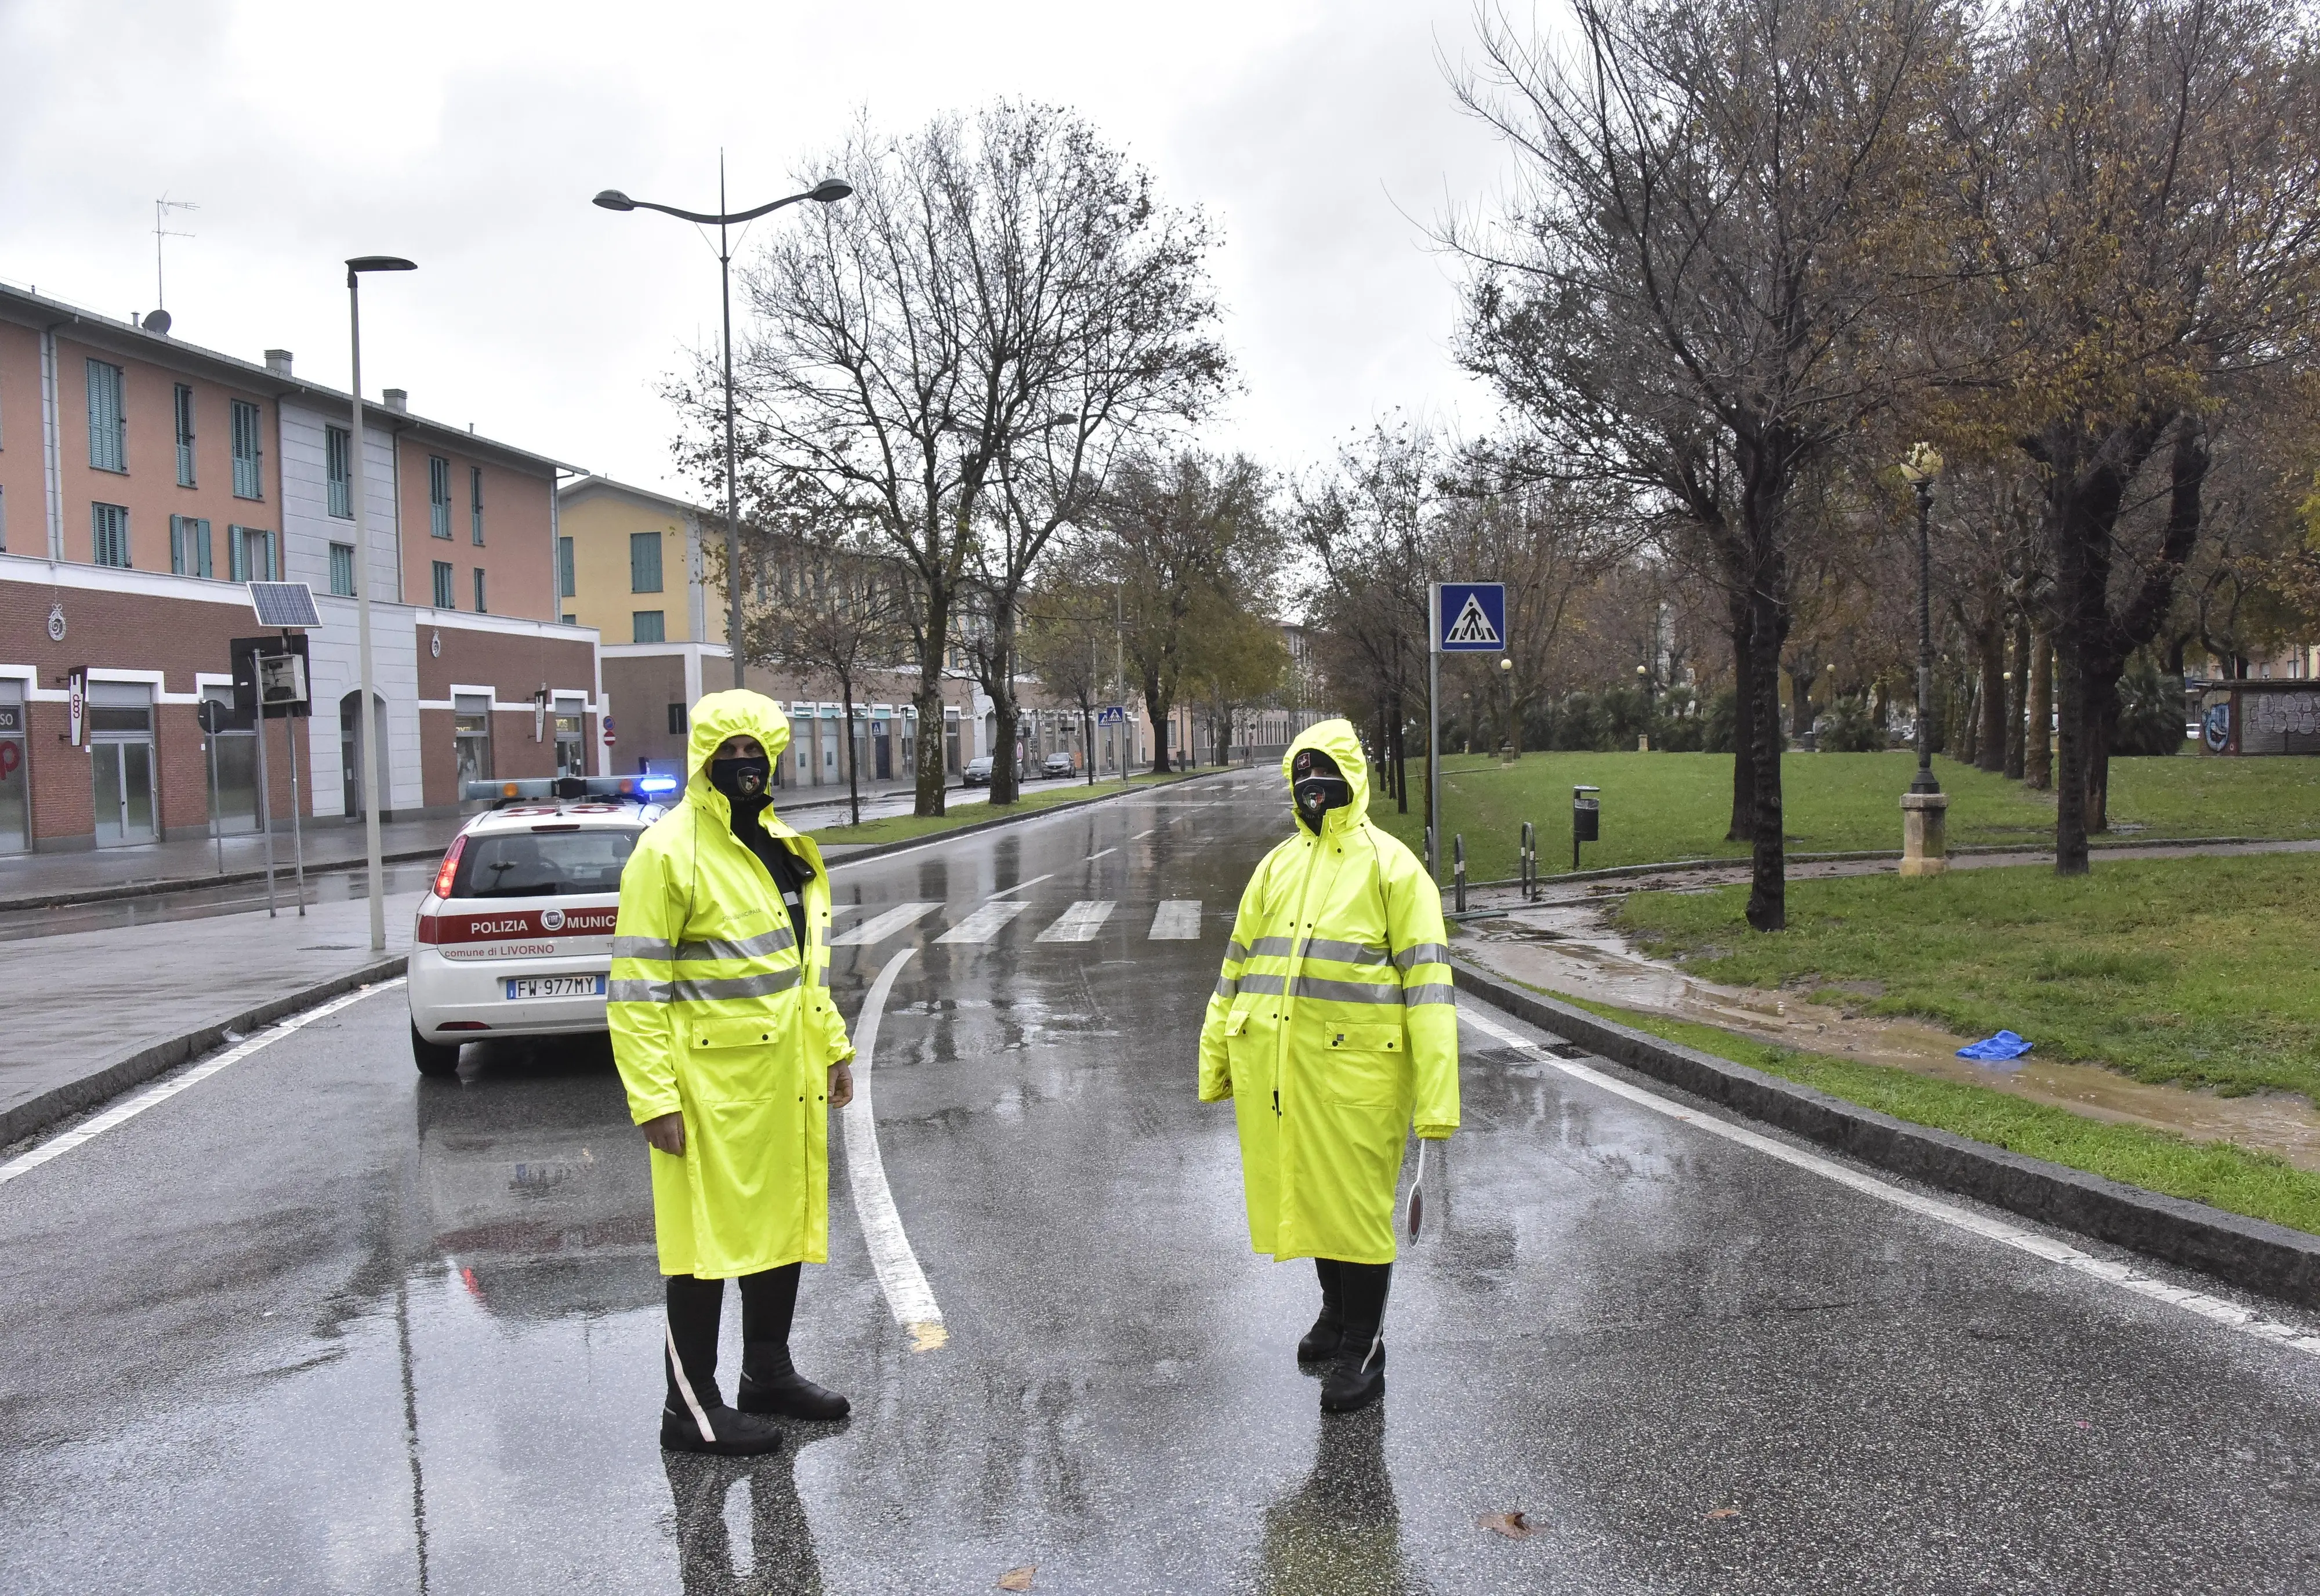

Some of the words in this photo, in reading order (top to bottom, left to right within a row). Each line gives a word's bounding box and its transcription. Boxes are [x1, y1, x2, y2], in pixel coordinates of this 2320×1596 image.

[471, 920, 528, 934] POLIZIA
[567, 915, 616, 928] MUNIC
[548, 915, 559, 923] FIAT
[445, 949, 484, 957] comune
[488, 947, 497, 956] di
[501, 945, 554, 956] LIVORNO
[518, 981, 537, 997] FW
[544, 977, 594, 995] 977MY
